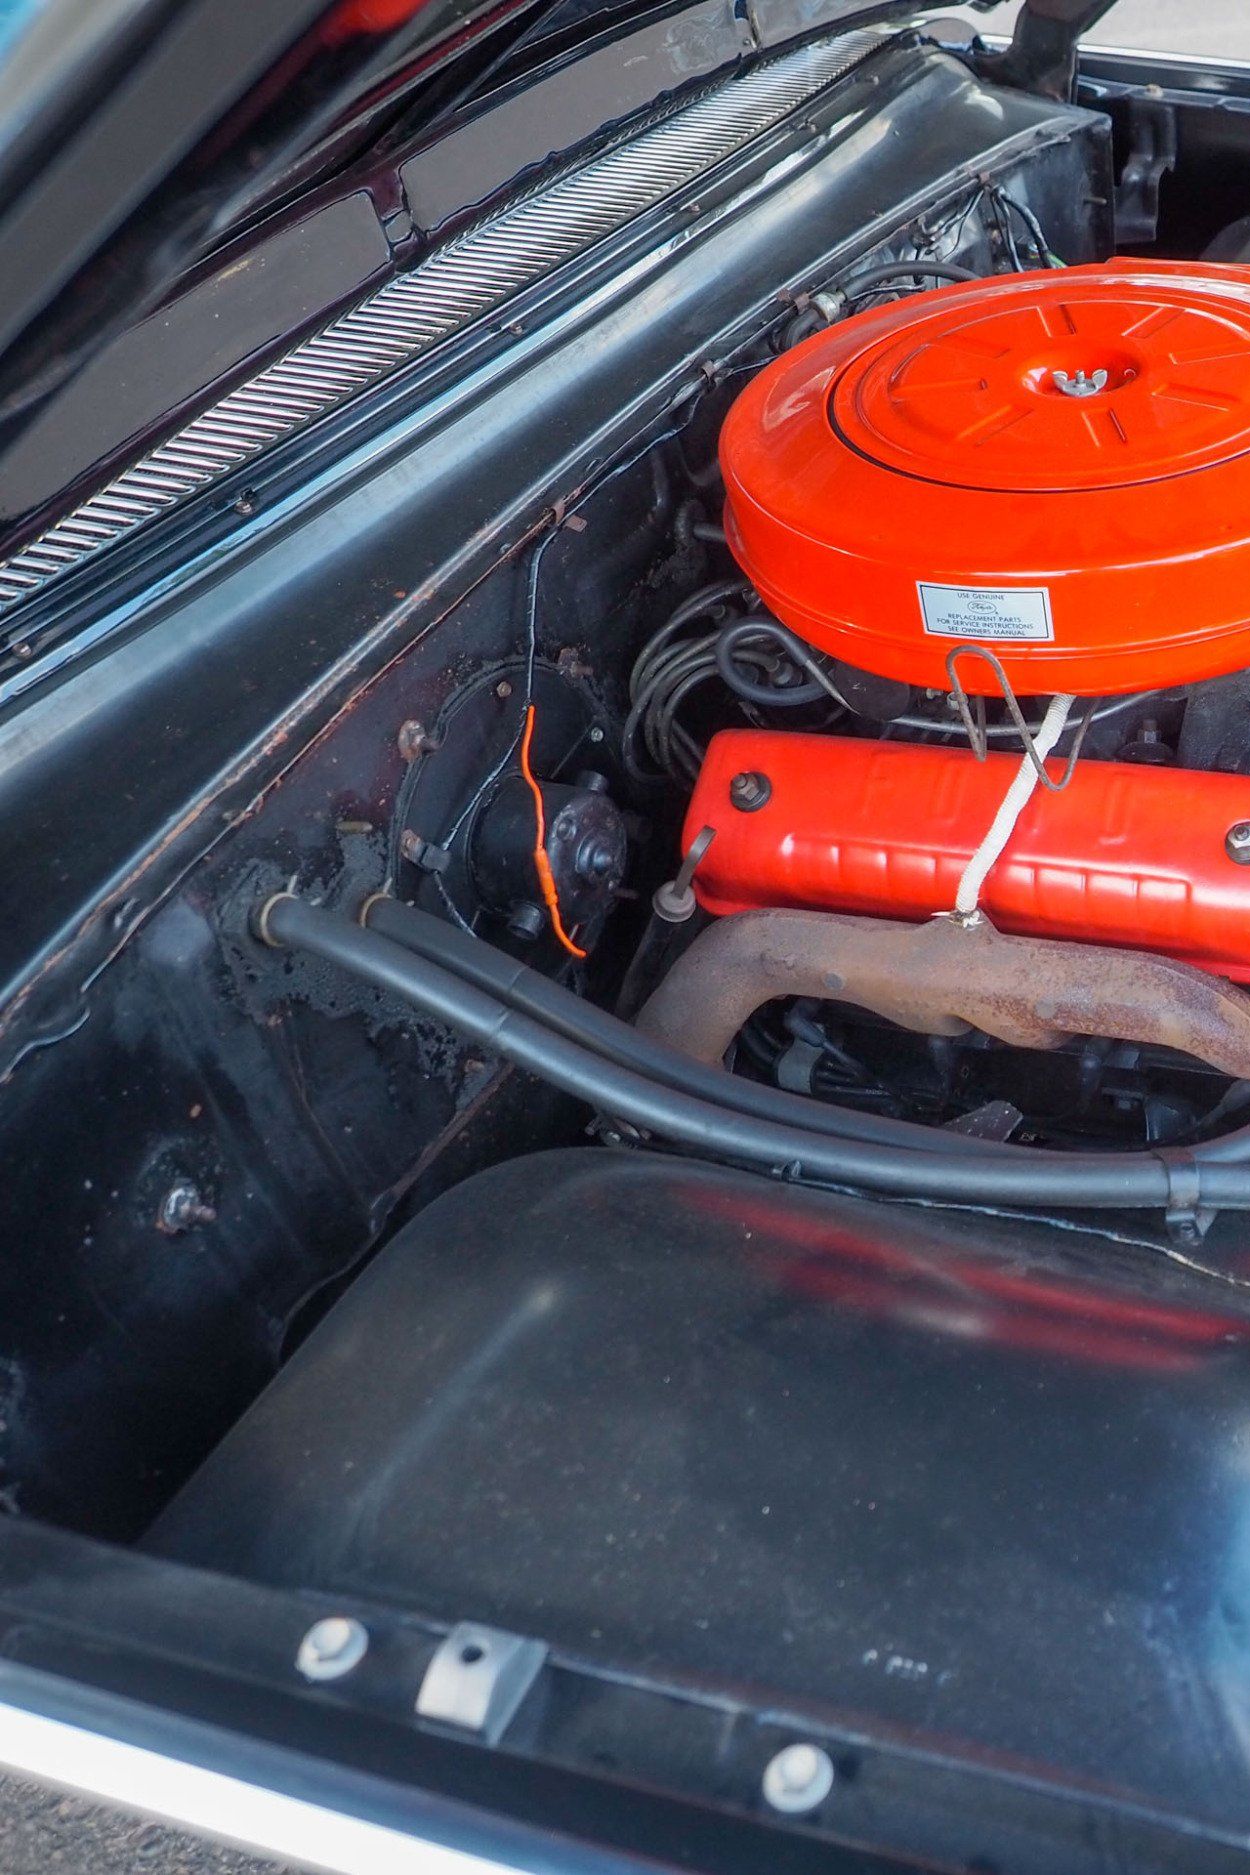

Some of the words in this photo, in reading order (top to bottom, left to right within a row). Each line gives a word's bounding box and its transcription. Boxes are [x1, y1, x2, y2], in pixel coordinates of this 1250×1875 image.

[947, 613, 996, 622] REPLACEMENT
[952, 620, 980, 628] SERVICE
[961, 627, 992, 635] OWNERS
